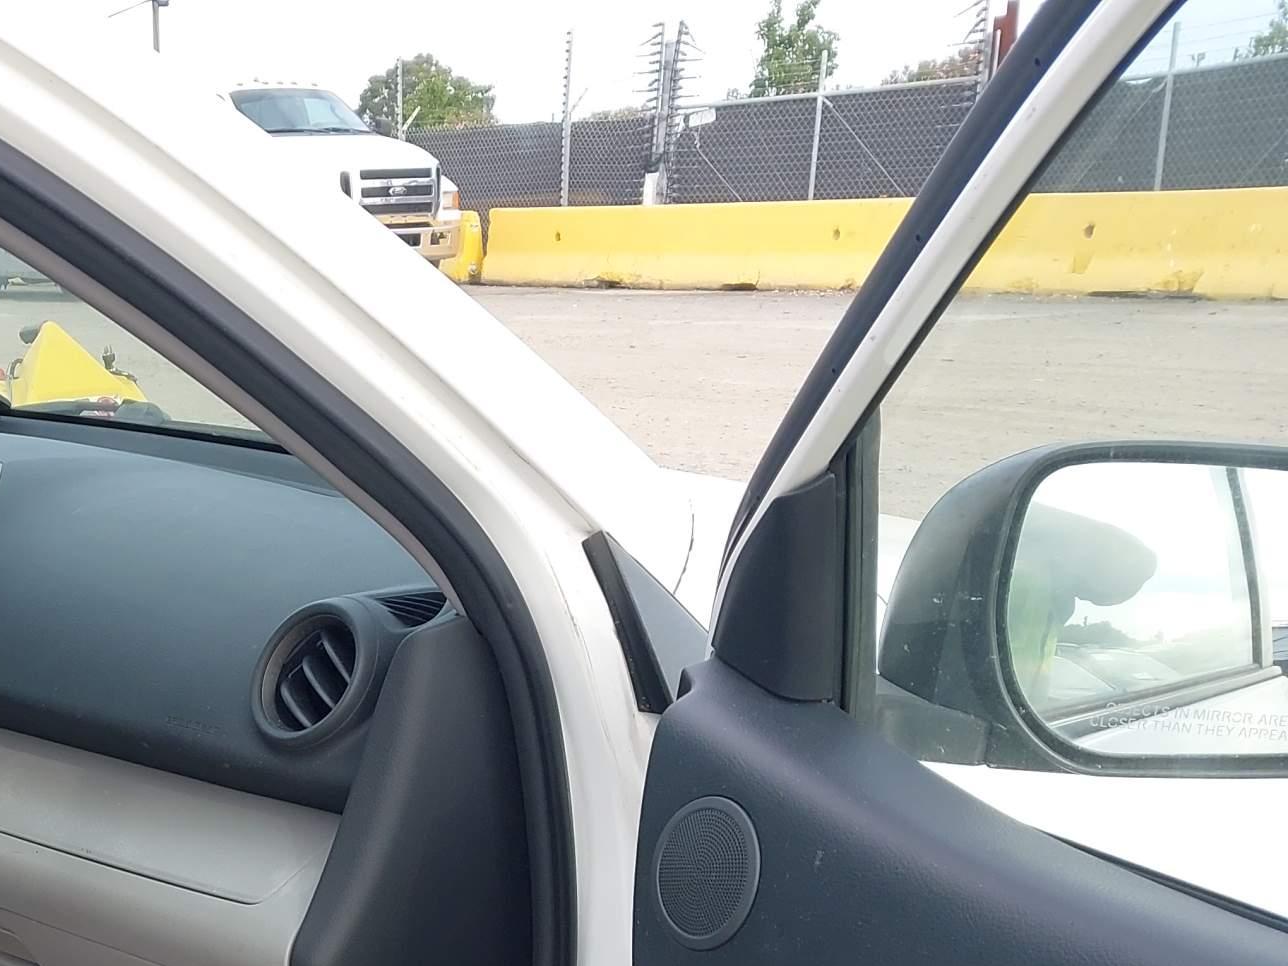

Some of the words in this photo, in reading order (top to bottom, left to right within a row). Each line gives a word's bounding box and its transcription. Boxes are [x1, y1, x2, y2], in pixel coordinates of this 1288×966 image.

[1193, 708, 1253, 724] MIRROR
[1257, 712, 1288, 727] ARE
[1196, 723, 1235, 737] THEY
